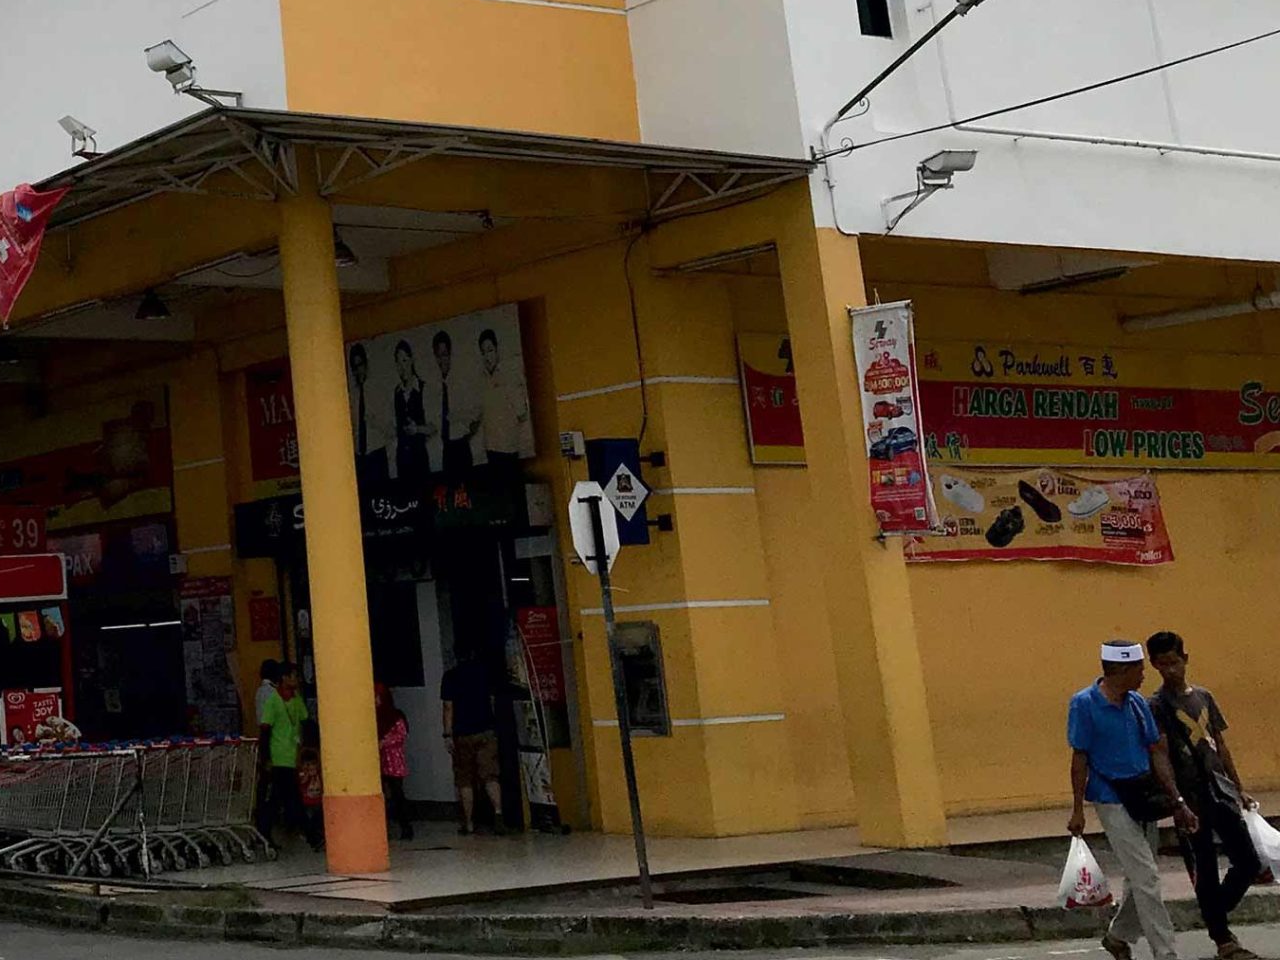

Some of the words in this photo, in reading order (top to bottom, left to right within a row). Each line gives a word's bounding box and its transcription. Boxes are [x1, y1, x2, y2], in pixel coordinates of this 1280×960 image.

[999, 350, 1072, 377] Parkwell
[952, 387, 1029, 419] HARGA
[1032, 389, 1119, 420] RENDAH
[1082, 428, 1129, 458] LOW
[1131, 429, 1206, 460] PRICES
[619, 501, 636, 509] ATM
[11, 517, 40, 549] 39
